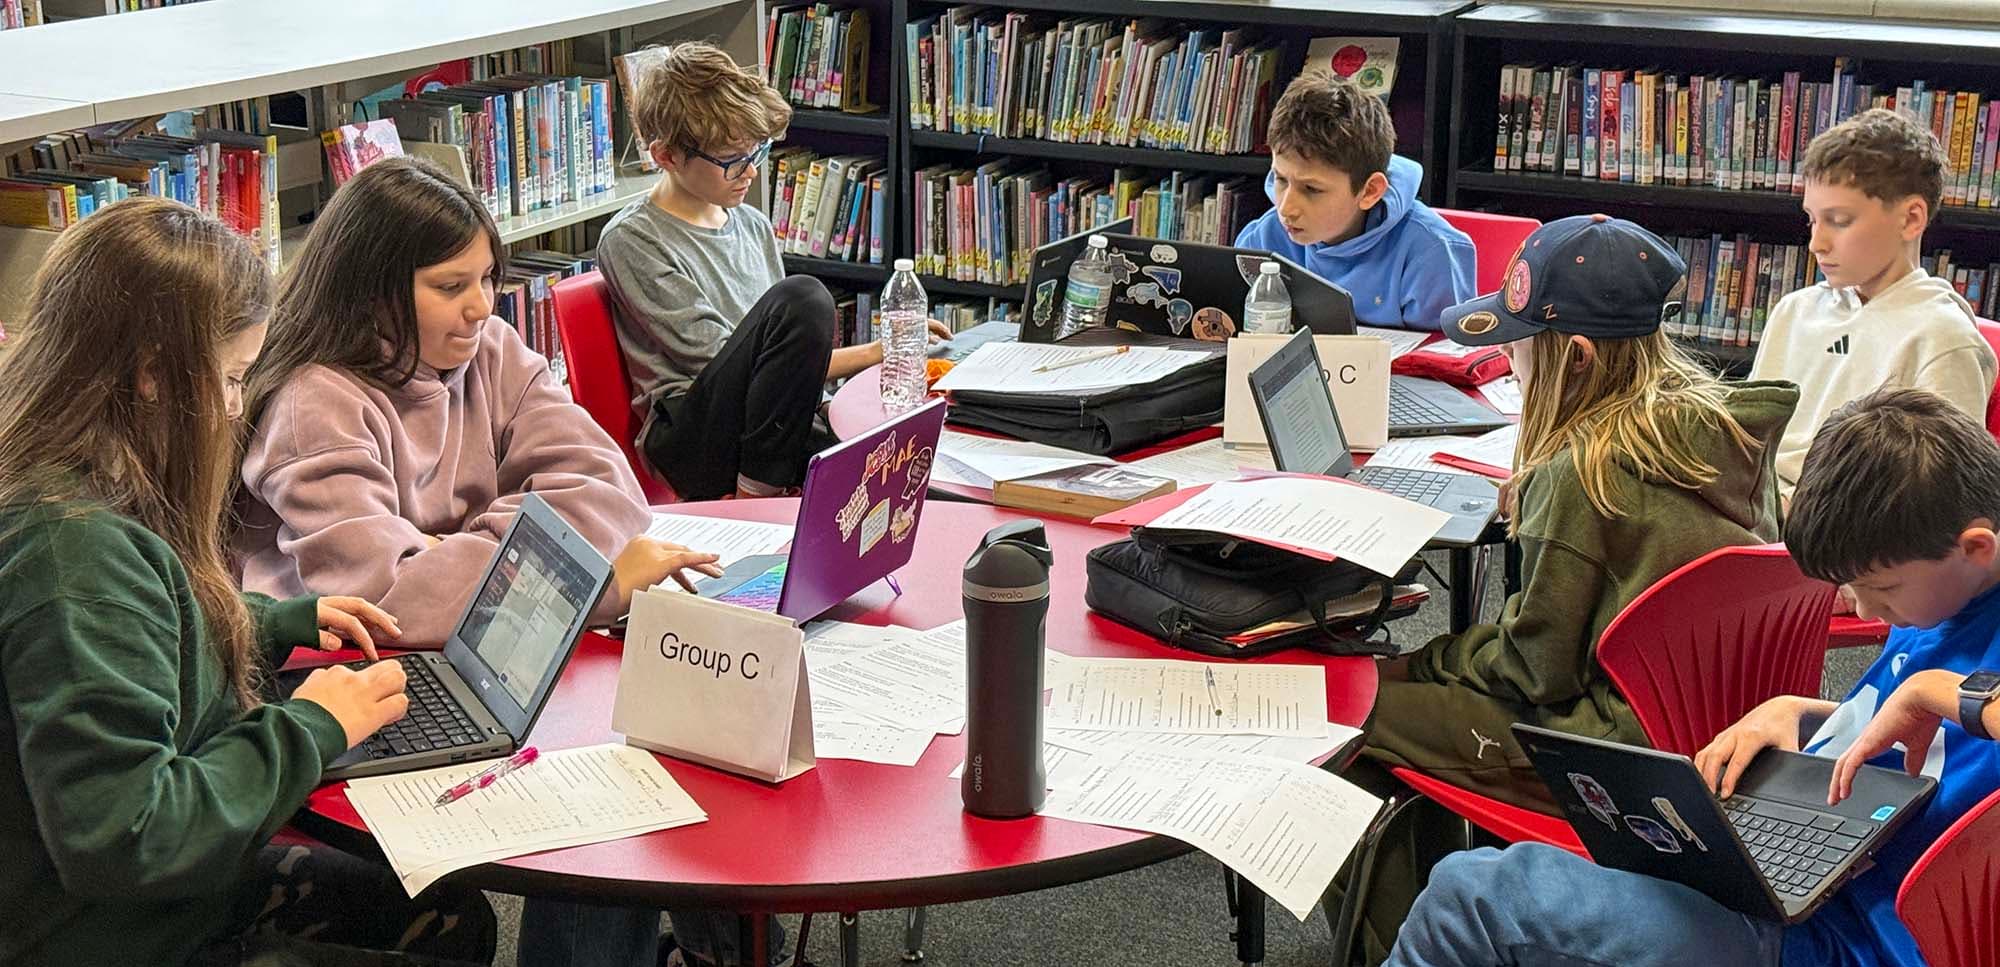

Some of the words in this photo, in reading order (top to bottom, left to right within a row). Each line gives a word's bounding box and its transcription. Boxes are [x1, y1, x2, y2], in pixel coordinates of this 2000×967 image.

[1779, 105, 1792, 160] SPIN
[1339, 364, 1357, 385] C
[881, 434, 917, 486] MAE
[990, 590, 1024, 600] owala
[660, 632, 731, 678] Group
[740, 652, 760, 680] C
[972, 754, 983, 792] owala
